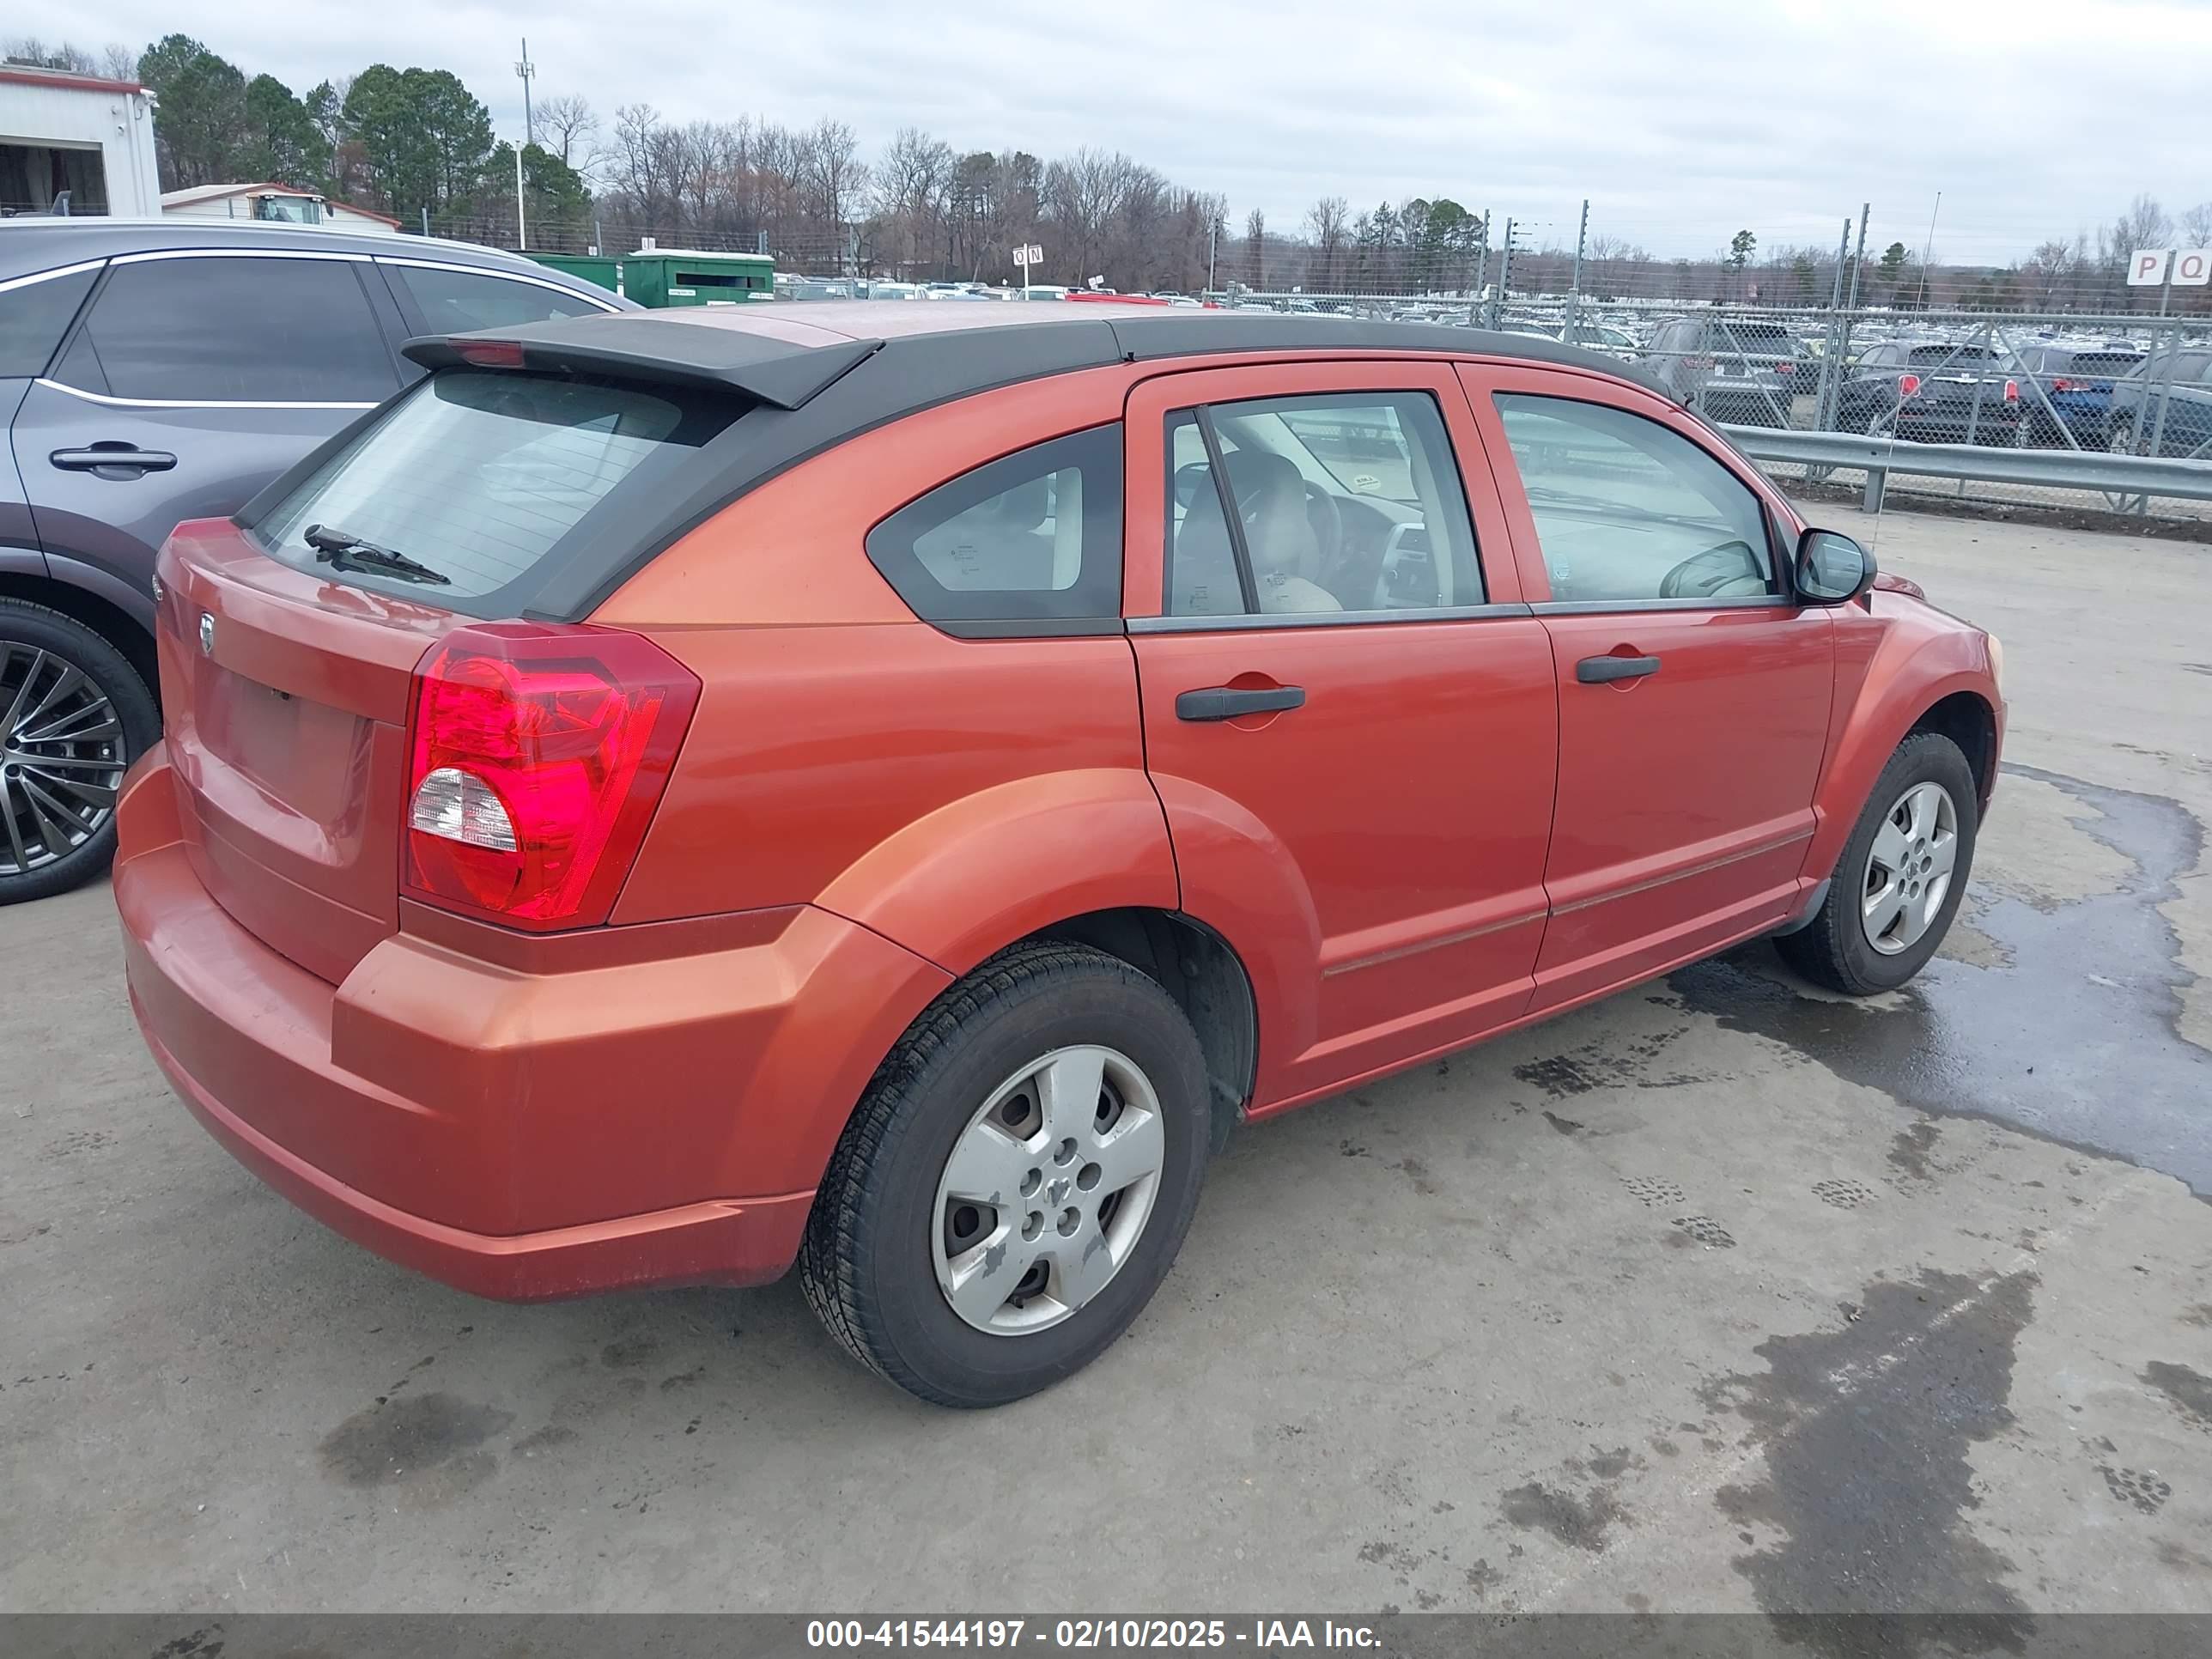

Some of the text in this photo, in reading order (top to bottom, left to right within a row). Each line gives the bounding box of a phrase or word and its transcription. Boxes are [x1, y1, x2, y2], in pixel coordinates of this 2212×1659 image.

[1016, 248, 1040, 263] O N
[2138, 255, 2203, 279] P Q
